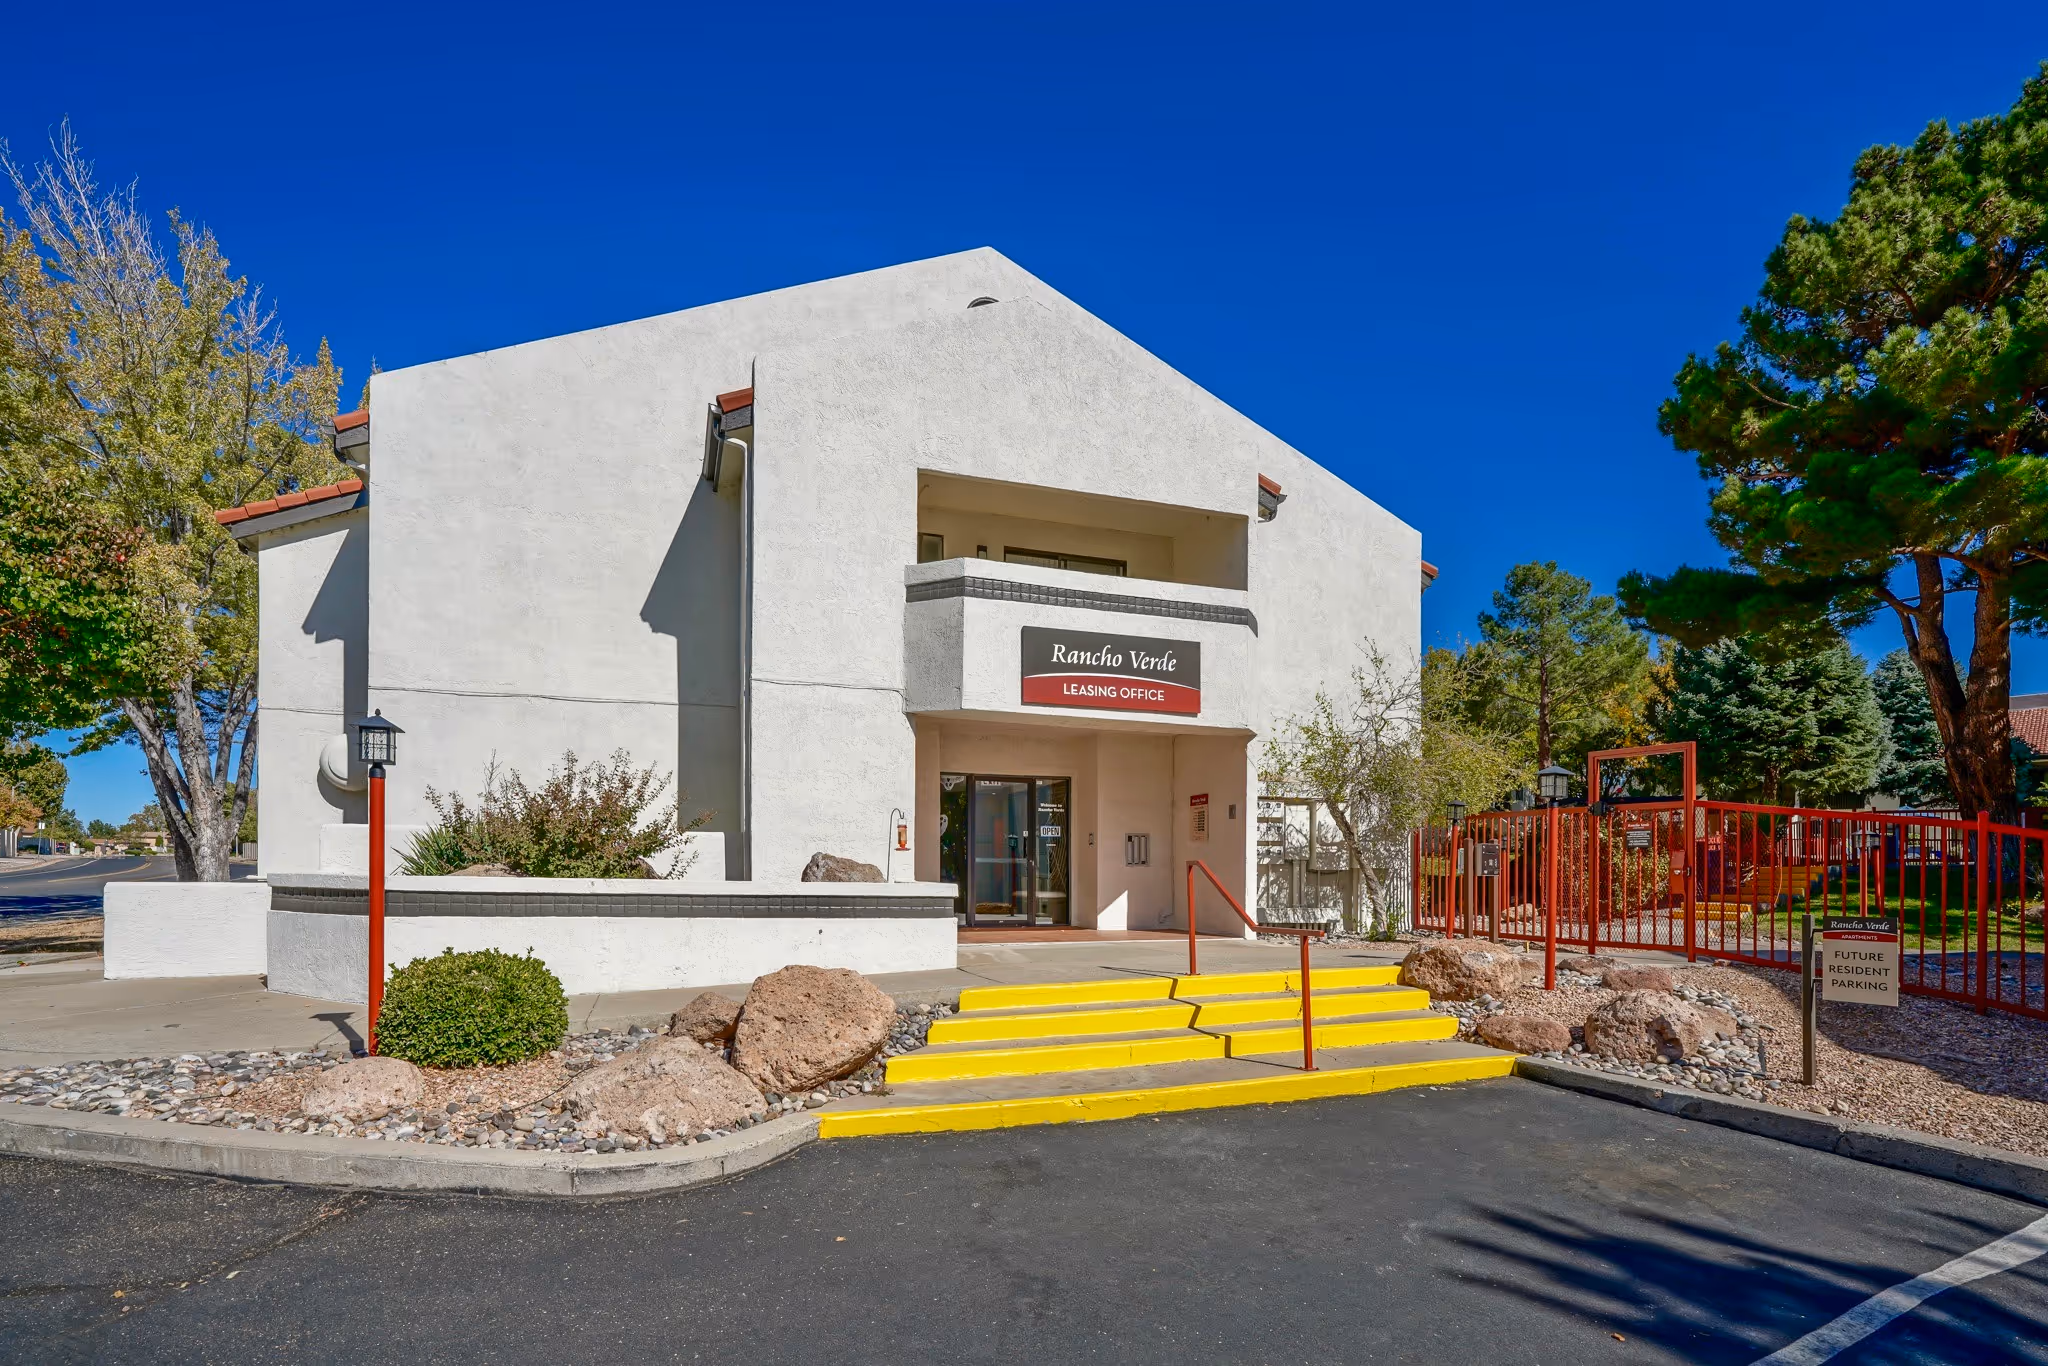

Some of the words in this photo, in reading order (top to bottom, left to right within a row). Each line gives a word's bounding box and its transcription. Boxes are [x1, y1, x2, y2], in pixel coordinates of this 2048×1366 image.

[1050, 643, 1122, 667] Rancho
[1129, 650, 1177, 672] Verde
[1063, 683, 1117, 698] LEASING
[1120, 687, 1165, 701] OFFICE
[1042, 827, 1060, 836] OPEN
[1830, 920, 1863, 930] Rancho
[1865, 921, 1890, 930] Verde
[1834, 950, 1884, 962] FUTURE
[1828, 964, 1891, 977] RESIDENT
[1831, 978, 1888, 991] PARKING
